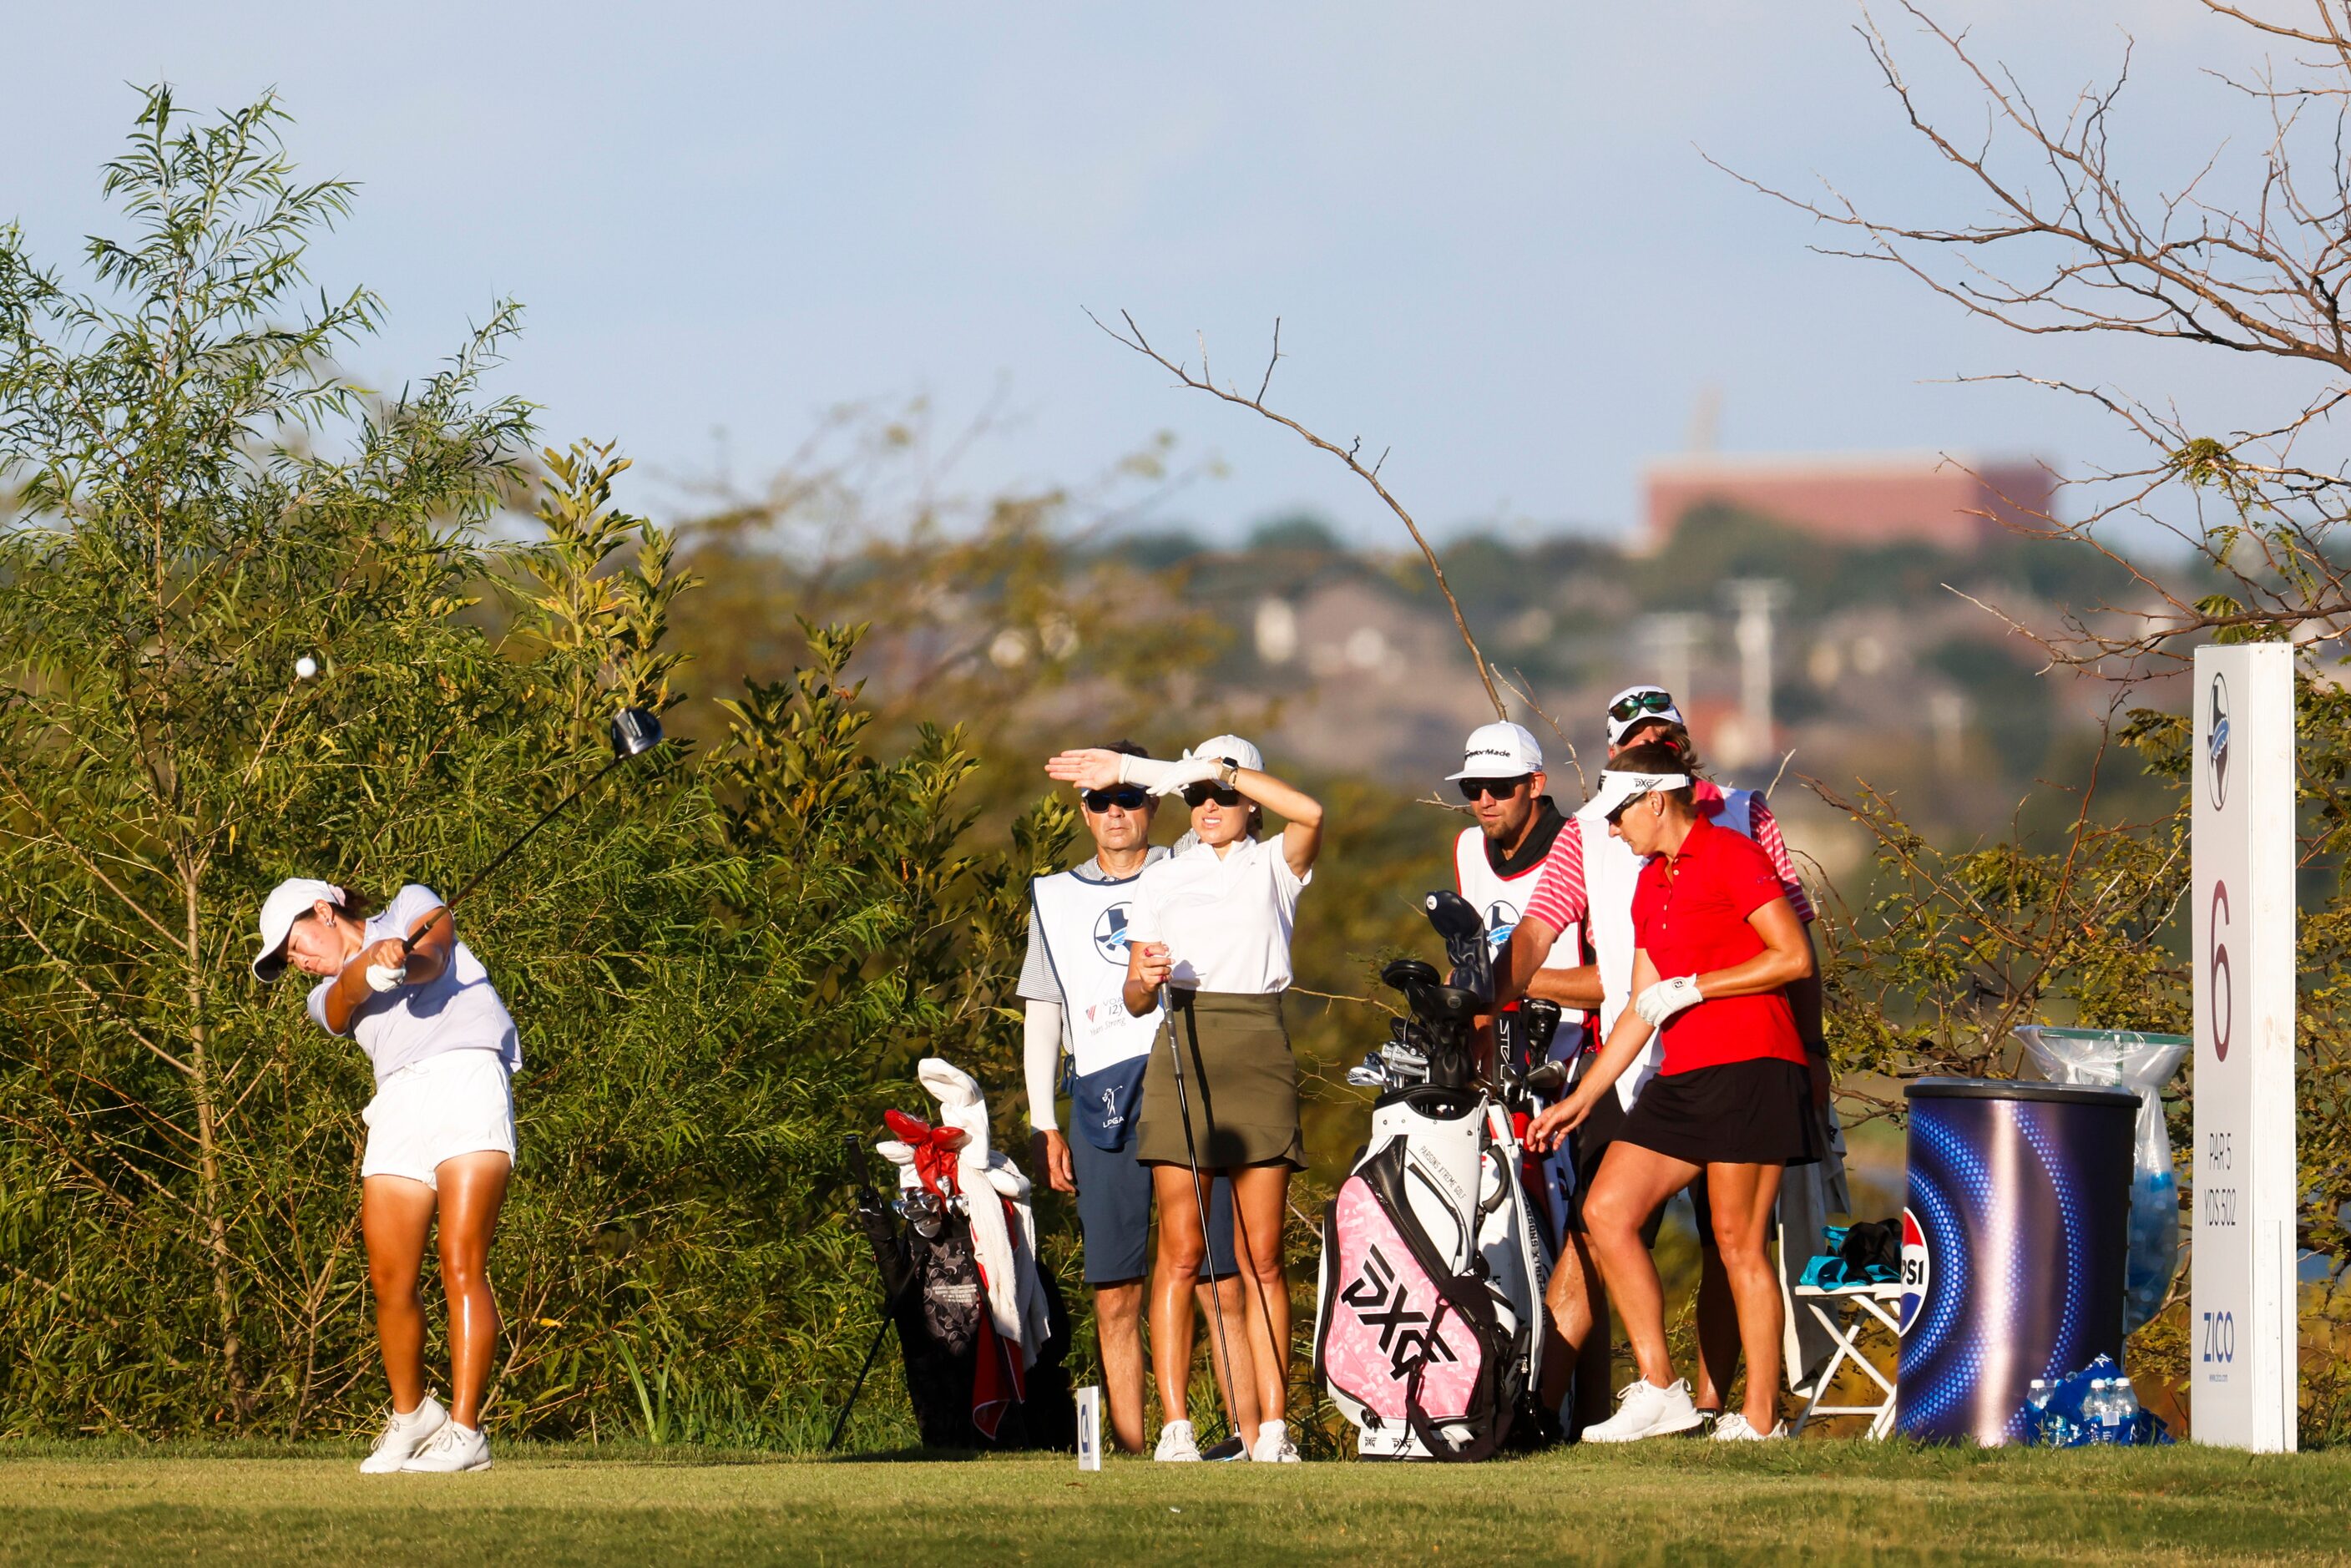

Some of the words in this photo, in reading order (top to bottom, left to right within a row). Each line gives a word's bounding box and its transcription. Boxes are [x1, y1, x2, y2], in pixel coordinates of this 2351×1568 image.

[2211, 879, 2231, 1063] 6
[1103, 1115, 1125, 1128] LPGA
[1419, 1145, 1441, 1169] PARSONS
[1438, 1166, 1458, 1187] XTREME
[1454, 1185, 1468, 1199] GOLF
[2209, 1132, 2225, 1170] PAR
[2227, 1132, 2232, 1170] 5
[2204, 1189, 2220, 1226] YDS
[2221, 1189, 2237, 1226] 502
[2203, 1311, 2234, 1363] ZICO
